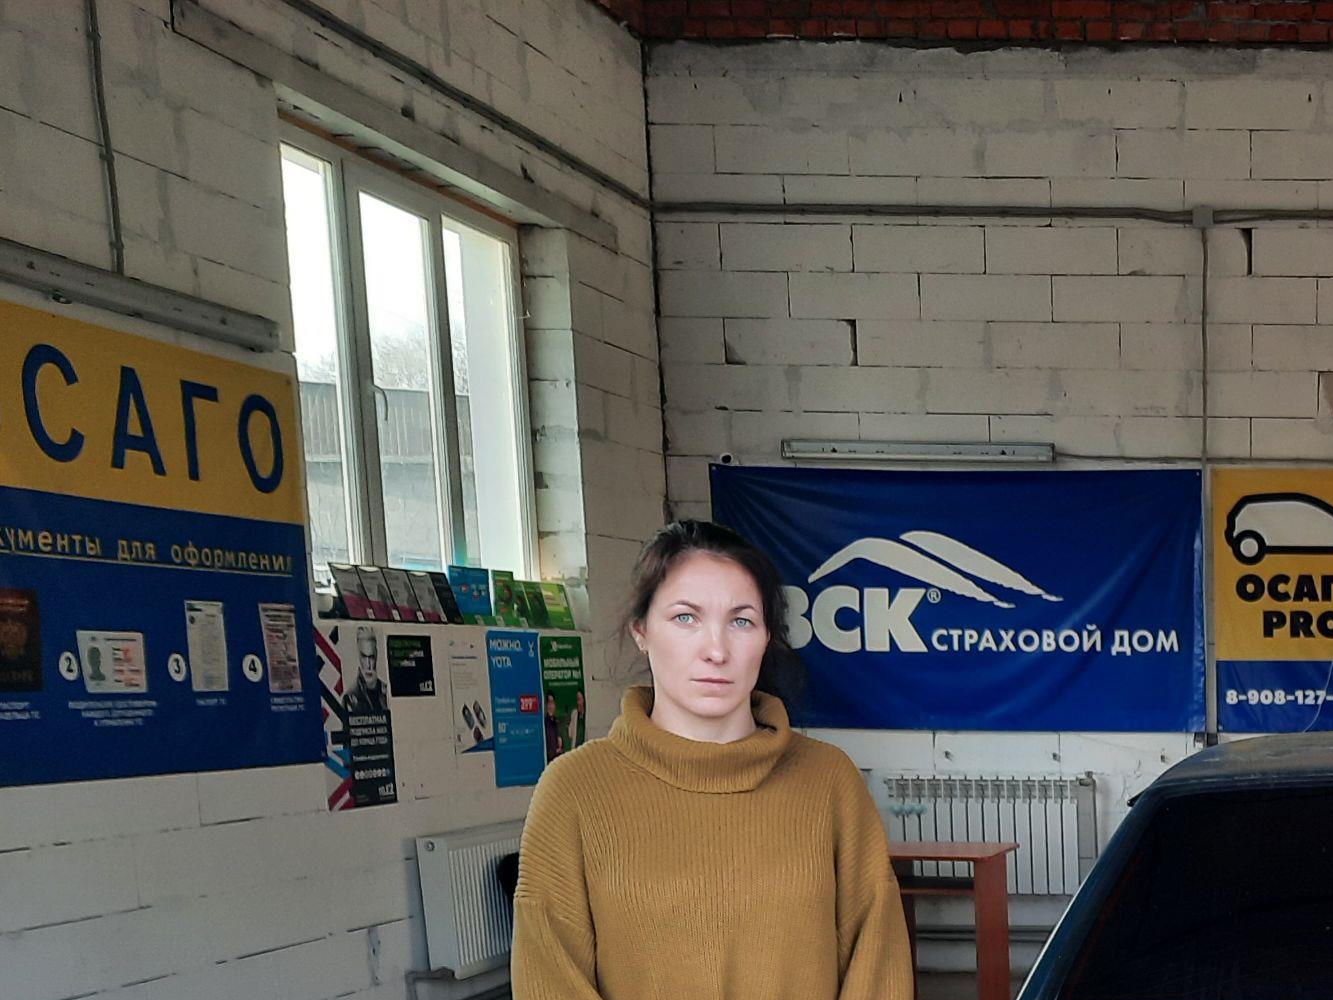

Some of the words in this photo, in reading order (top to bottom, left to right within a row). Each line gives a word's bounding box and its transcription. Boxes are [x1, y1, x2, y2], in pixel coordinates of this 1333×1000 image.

[117, 539, 156, 561] для
[931, 624, 1101, 652] СТРАХОВОЙ
[1110, 630, 1179, 655] ДОМ
